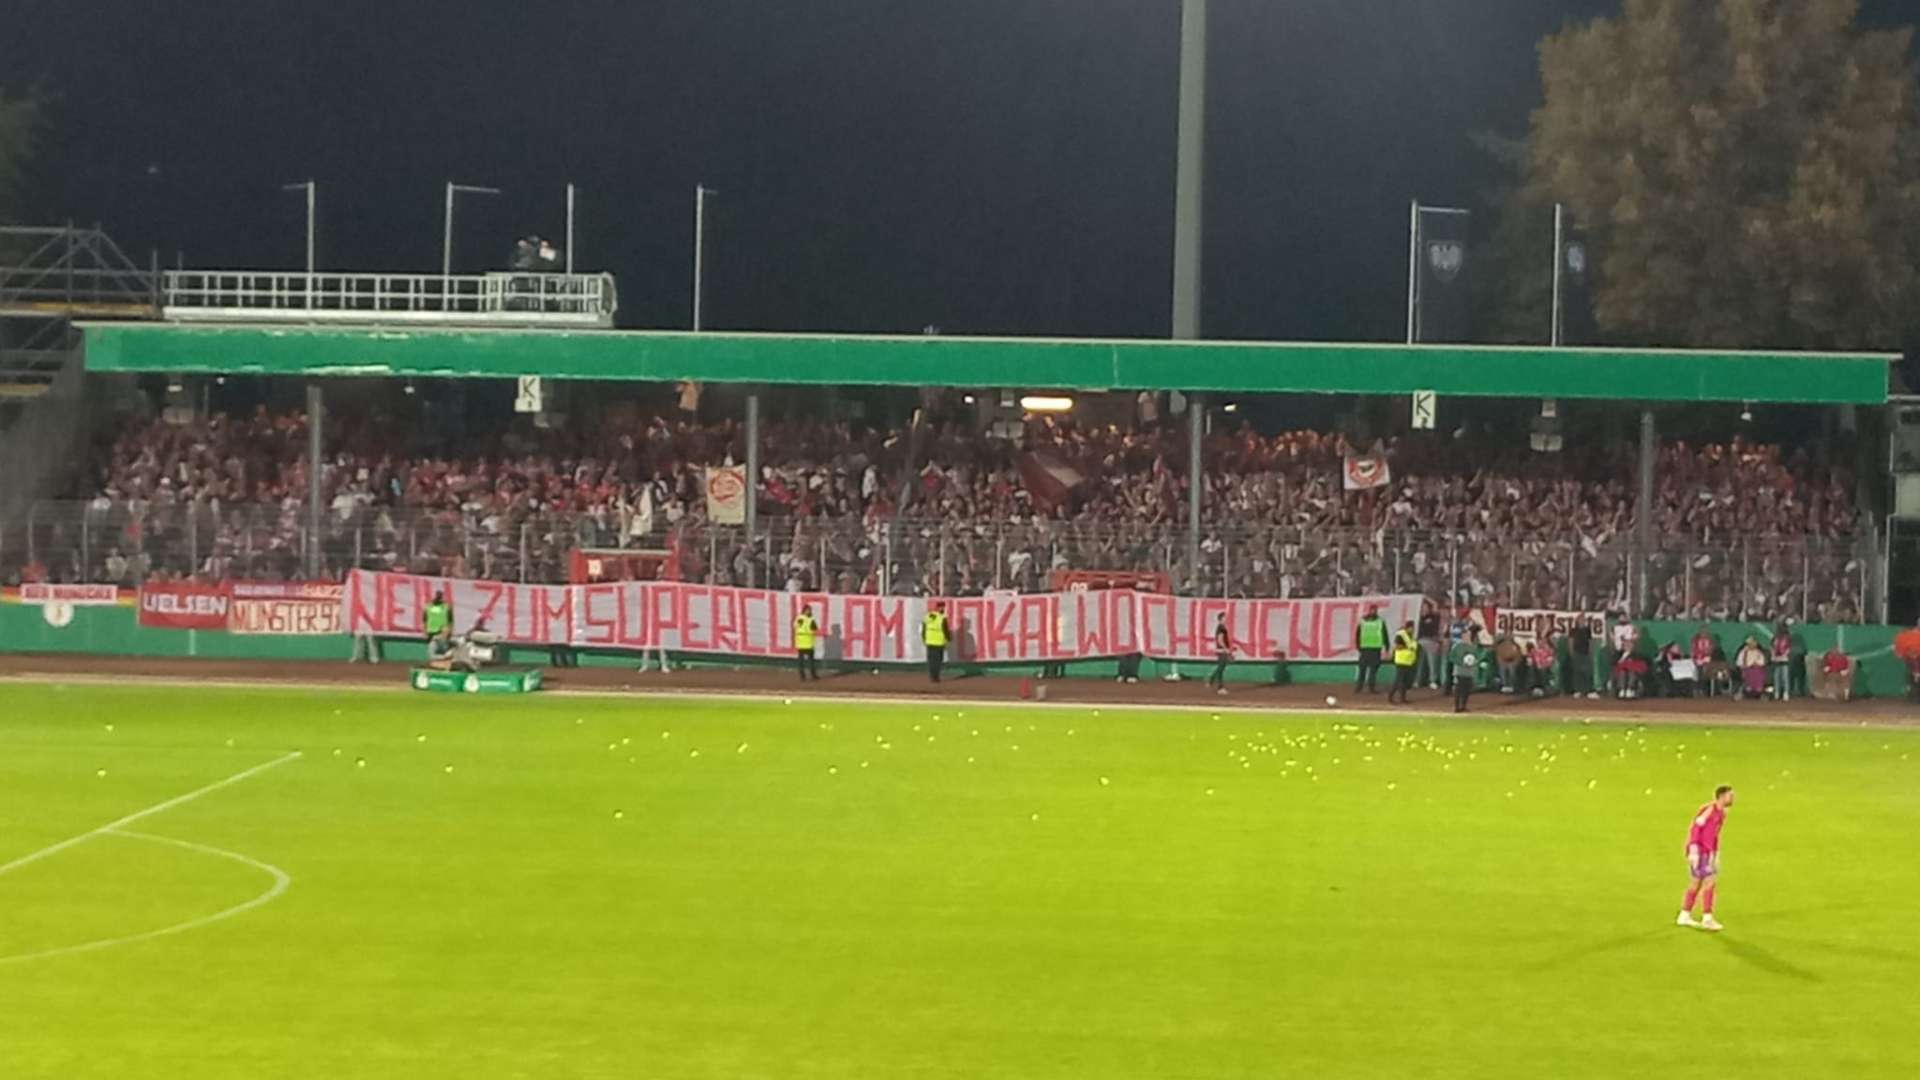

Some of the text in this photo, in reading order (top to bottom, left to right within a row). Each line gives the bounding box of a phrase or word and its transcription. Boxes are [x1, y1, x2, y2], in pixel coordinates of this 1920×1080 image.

[1416, 392, 1432, 416] K
[143, 593, 227, 615] UELSEN
[843, 597, 904, 659] AM
